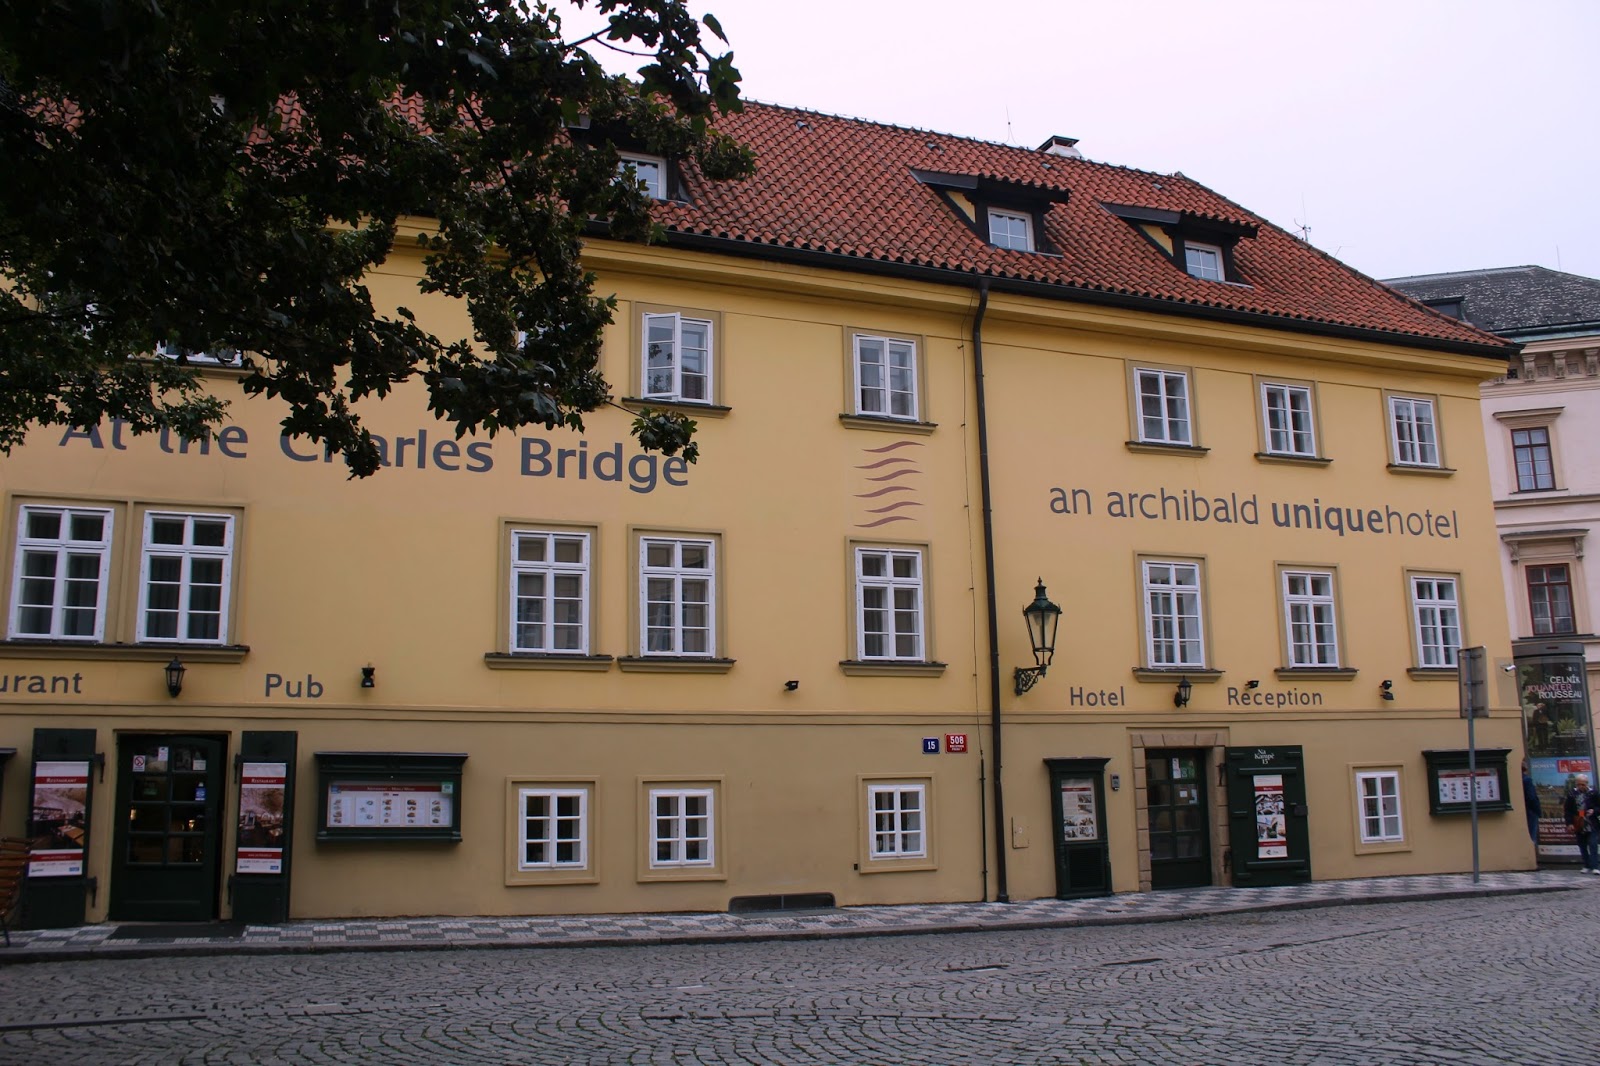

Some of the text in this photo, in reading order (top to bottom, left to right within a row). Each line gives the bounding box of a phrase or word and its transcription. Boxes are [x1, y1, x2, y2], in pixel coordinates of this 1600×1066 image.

[280, 428, 494, 473] Carles
[521, 437, 689, 494] Bridge
[1049, 487, 1459, 538] an archibald uniquehotel
[265, 673, 324, 698] Pub
[1550, 674, 1581, 684] CELNÍK
[1070, 686, 1125, 707] Hotel
[1228, 686, 1323, 709] Reception
[1539, 690, 1582, 699] ROUSSEAU
[927, 741, 936, 750] 15
[950, 736, 964, 744] 508
